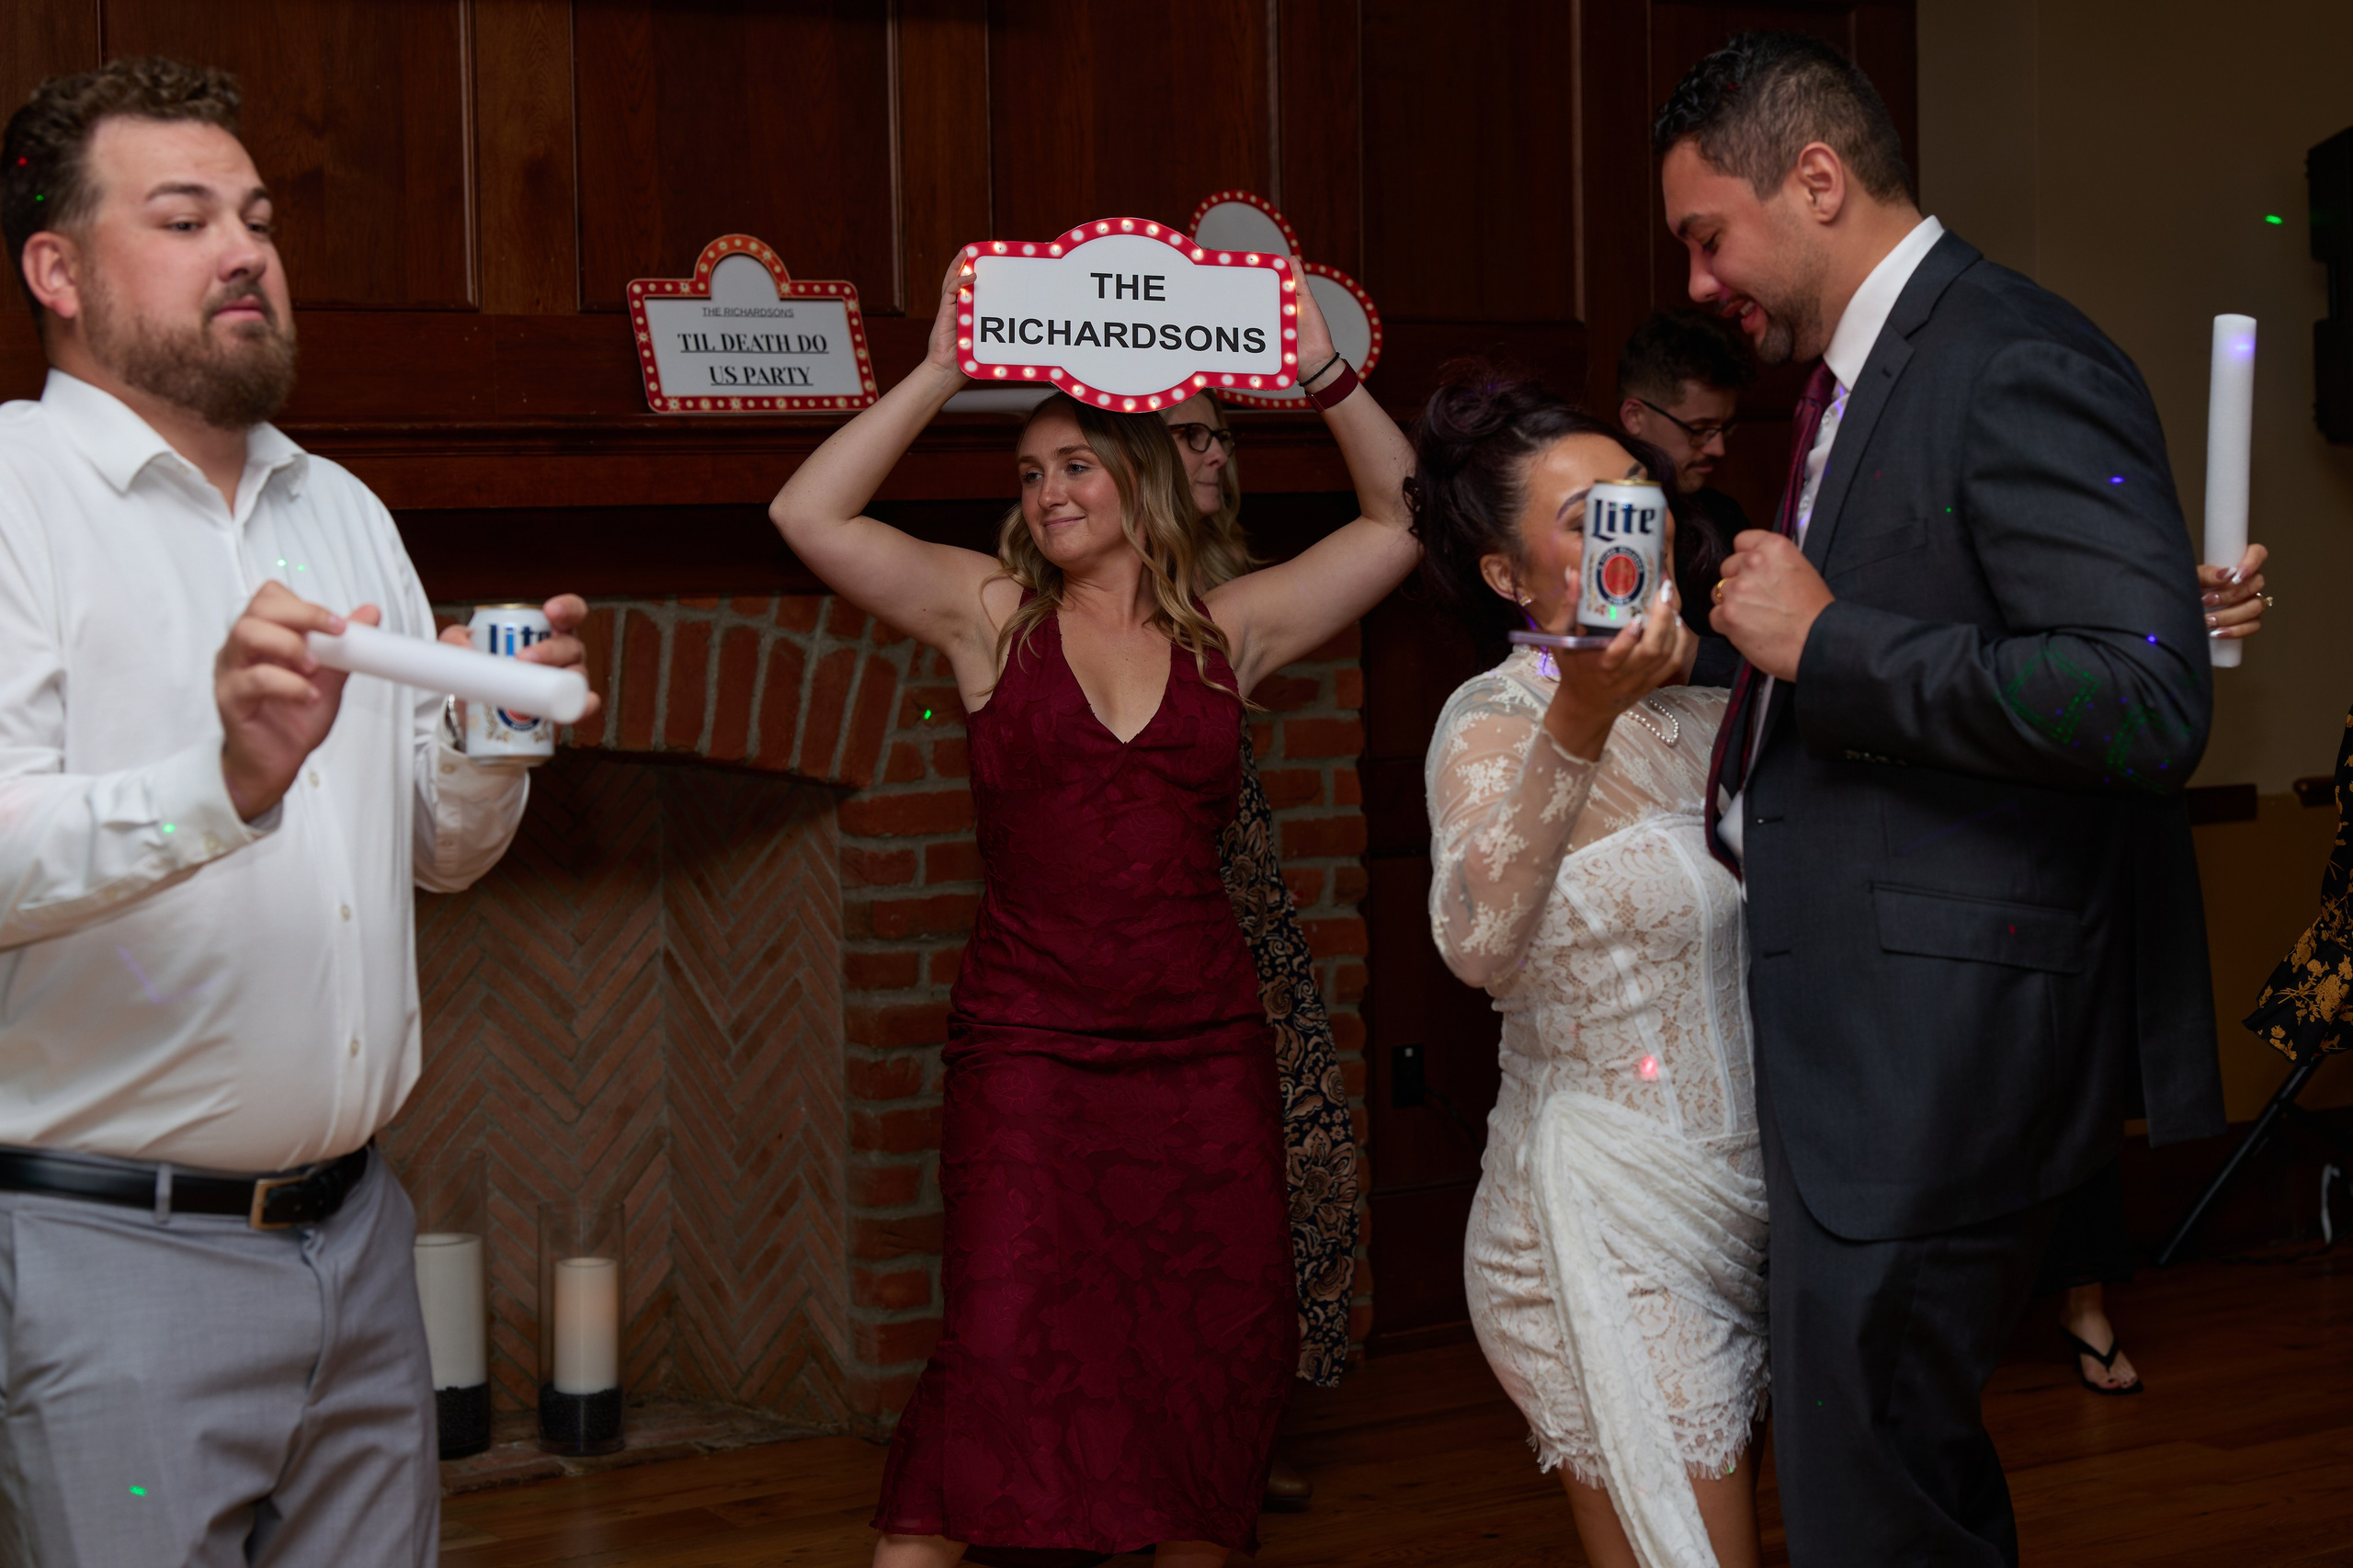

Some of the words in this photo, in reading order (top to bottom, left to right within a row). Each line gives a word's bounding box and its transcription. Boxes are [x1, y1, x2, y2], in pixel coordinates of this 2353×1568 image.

[1090, 272, 1166, 301] THE
[702, 307, 721, 317] THE
[723, 307, 794, 318] RICHARDSONS
[677, 333, 715, 352] TIL
[721, 333, 791, 353] DEATH
[797, 334, 828, 354] DO
[980, 316, 1267, 354] RICHARDSONS
[709, 366, 737, 385] US
[743, 366, 810, 385] PARTY
[1591, 499, 1655, 542] Lite
